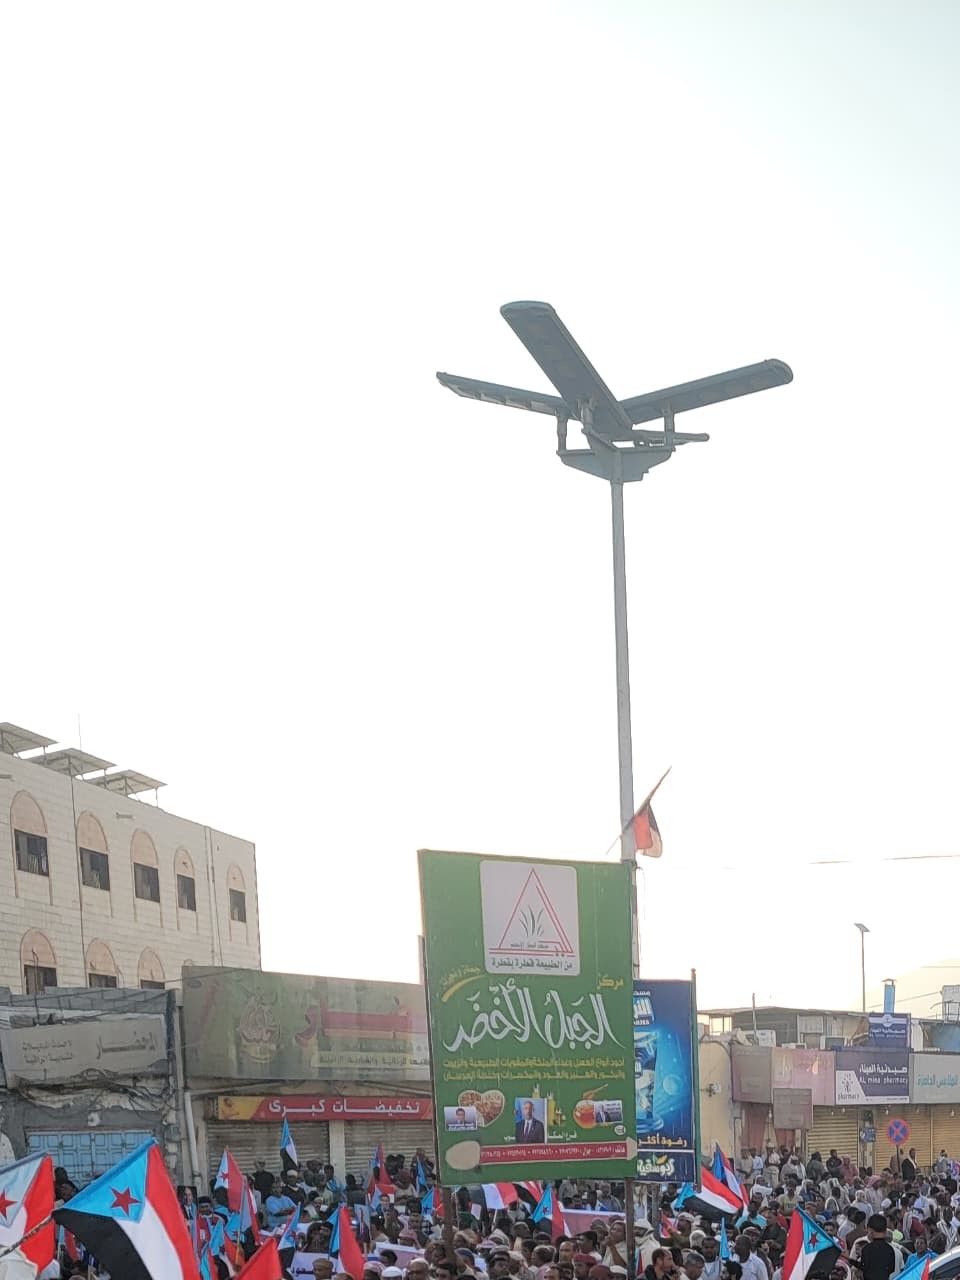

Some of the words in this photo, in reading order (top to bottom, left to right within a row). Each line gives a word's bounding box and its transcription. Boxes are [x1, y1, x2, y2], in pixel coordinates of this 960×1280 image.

[597, 974, 624, 990] مركز
[877, 1064, 908, 1075] صيدلية
[269, 1100, 325, 1116] كبرى
[332, 1099, 420, 1114] تخفيضات
